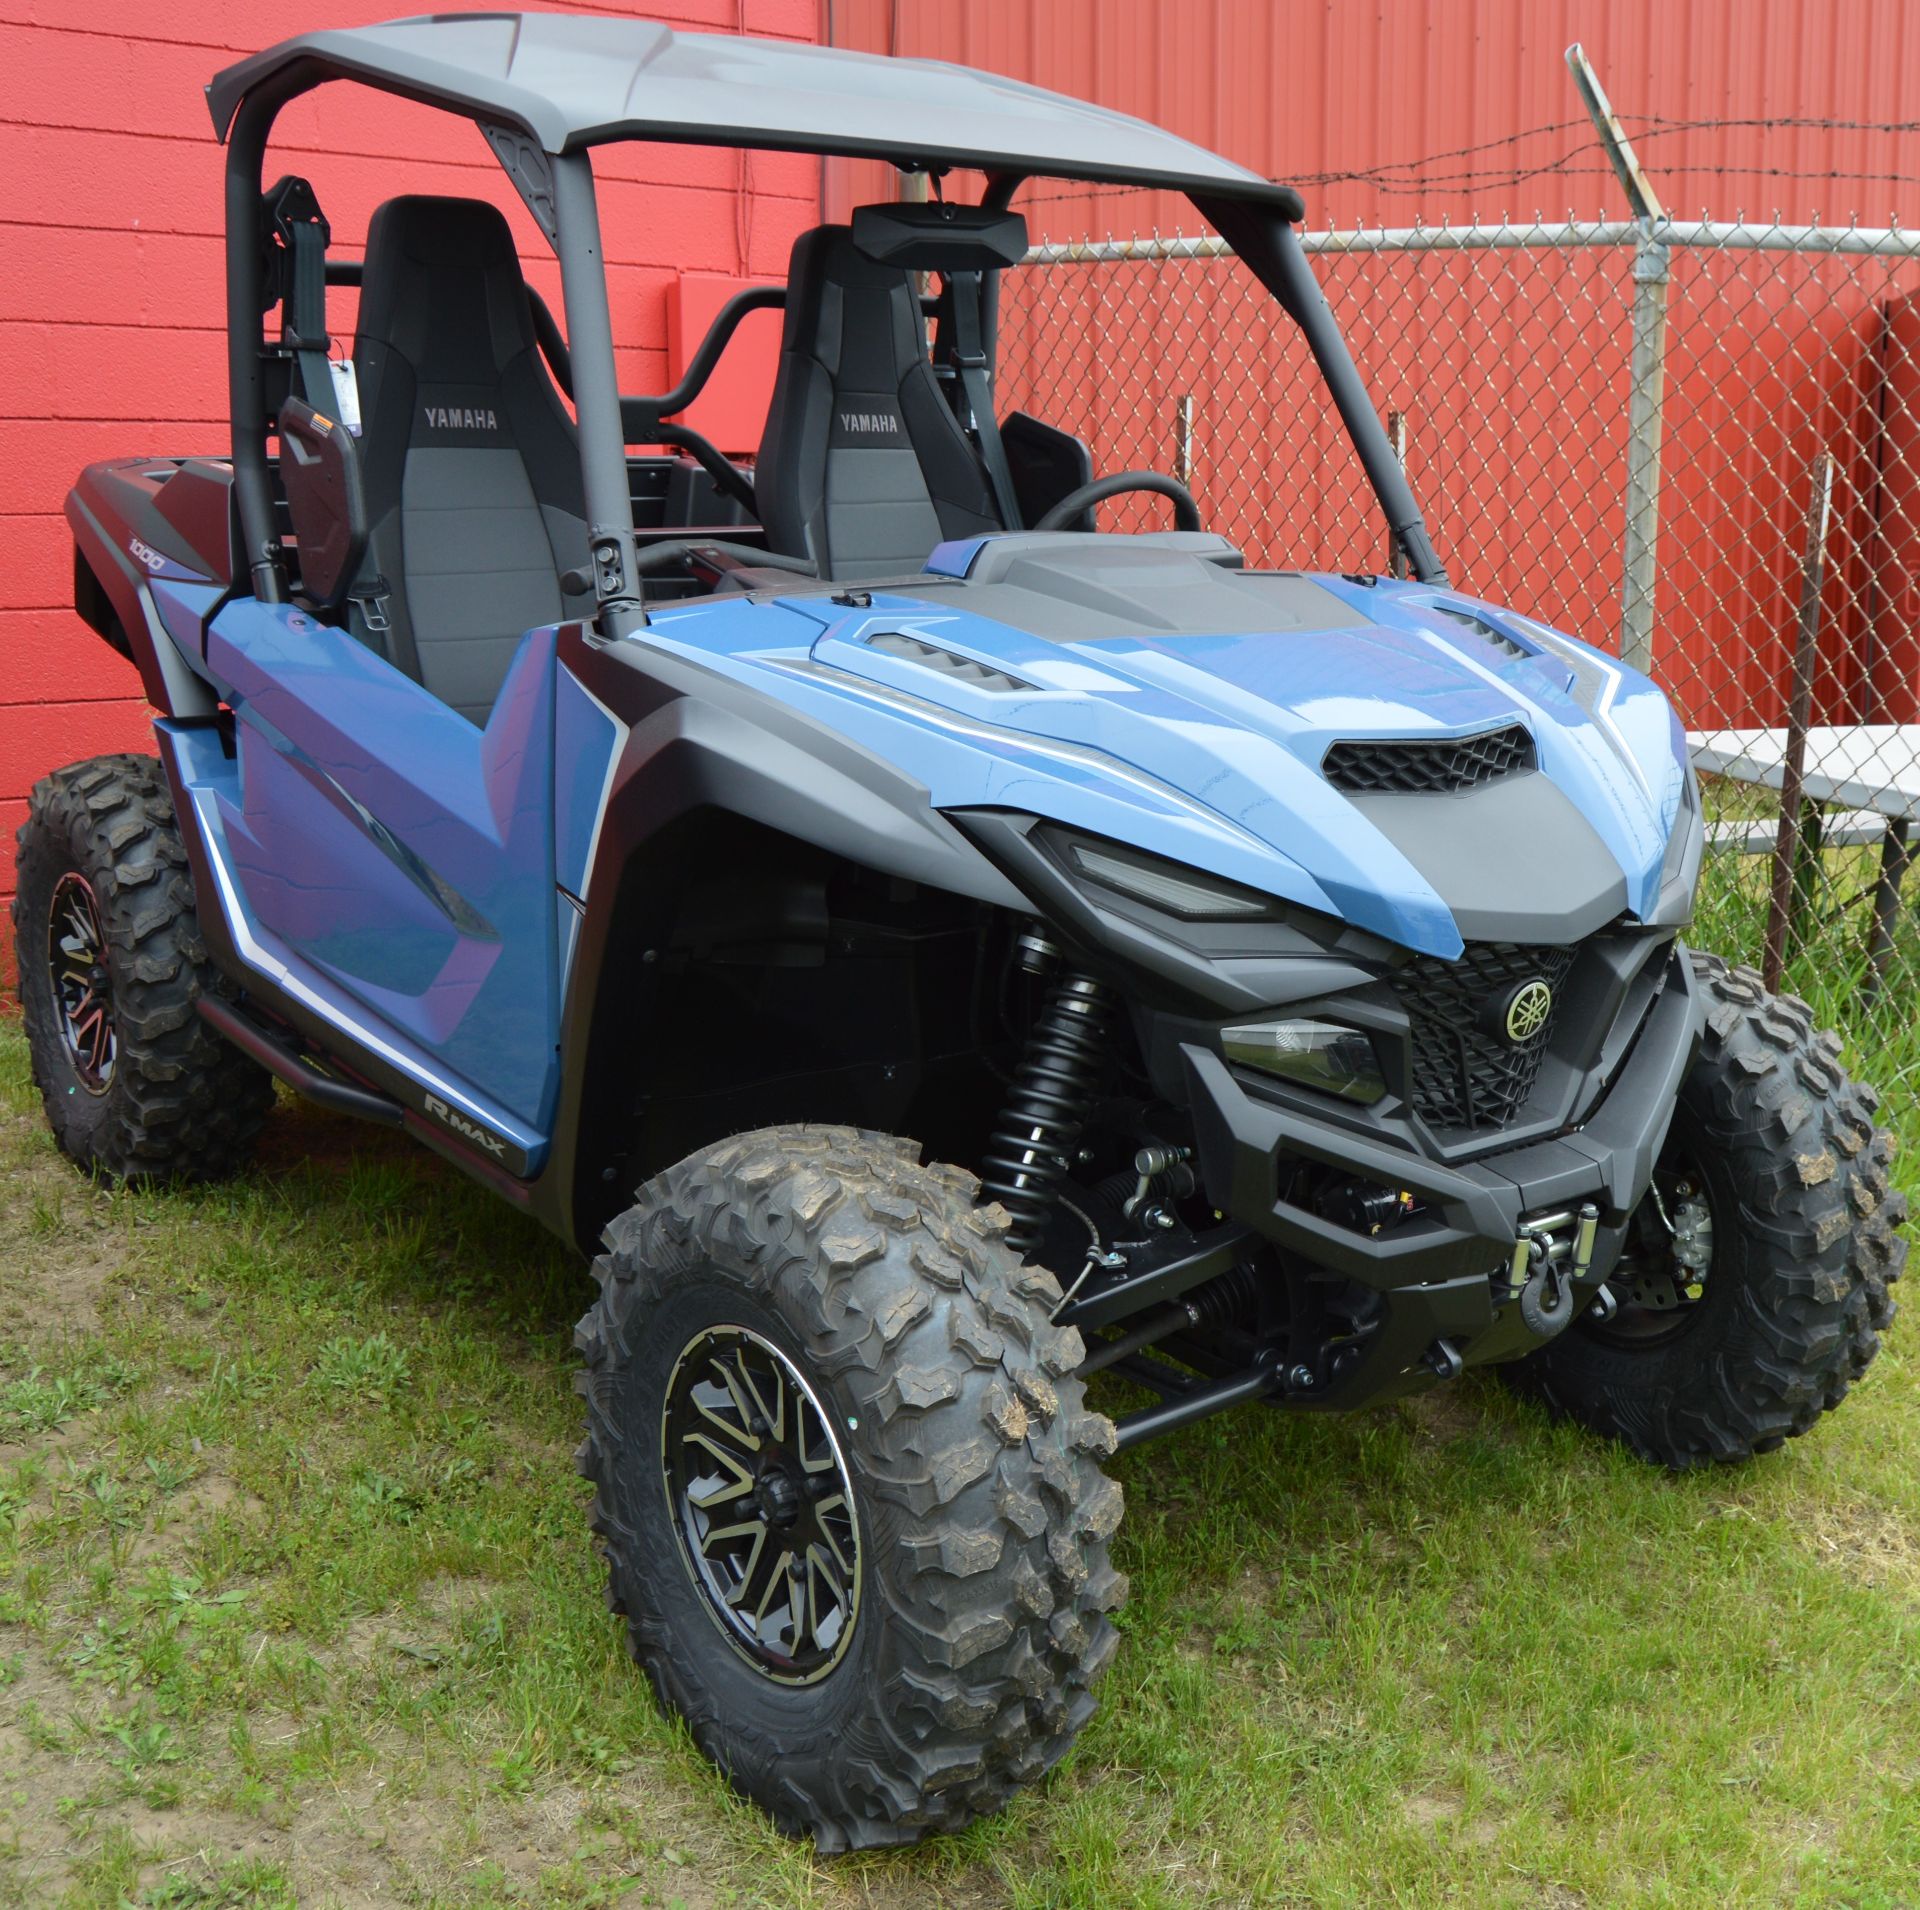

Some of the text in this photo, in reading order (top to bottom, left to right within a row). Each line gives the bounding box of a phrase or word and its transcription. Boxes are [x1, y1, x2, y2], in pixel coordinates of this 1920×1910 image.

[425, 407, 497, 430] YAMAHA
[840, 413, 897, 433] YAMAHA
[129, 538, 166, 570] 1000
[424, 1093, 506, 1159] RMAX
